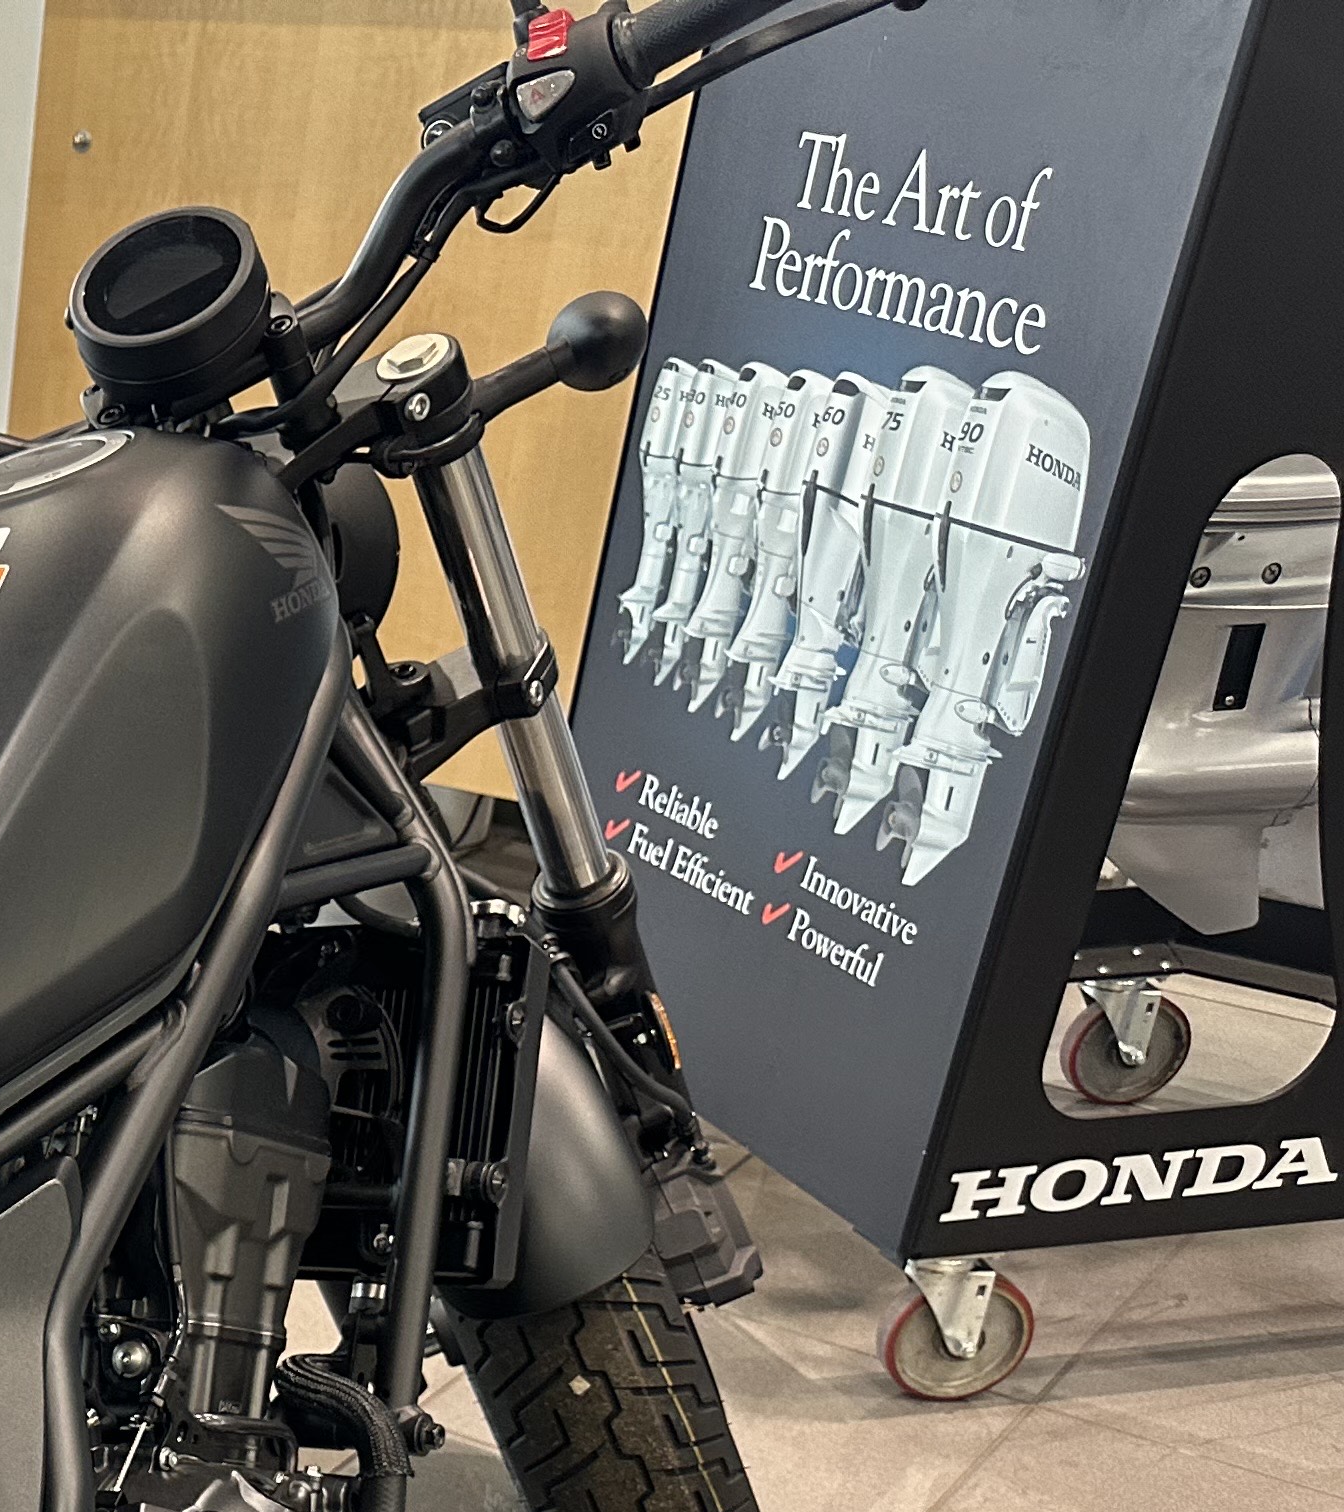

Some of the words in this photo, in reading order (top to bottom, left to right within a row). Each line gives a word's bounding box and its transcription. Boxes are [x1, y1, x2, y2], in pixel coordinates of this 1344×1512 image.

[796, 131, 880, 221] The
[881, 148, 981, 241] Art
[984, 166, 1053, 251] of
[749, 215, 1046, 355] Performance
[653, 385, 671, 400] 25
[775, 401, 796, 418] 50
[822, 406, 846, 425] 60
[881, 411, 904, 431] 75
[958, 421, 984, 443] 90
[1025, 443, 1082, 492] HONDA
[638, 773, 719, 839] Reliable
[627, 822, 674, 871] Fuel
[670, 845, 755, 916] Efficient
[799, 855, 918, 945] Innovative
[787, 908, 885, 988] Powerful
[938, 1136, 1338, 1223] HONDA
